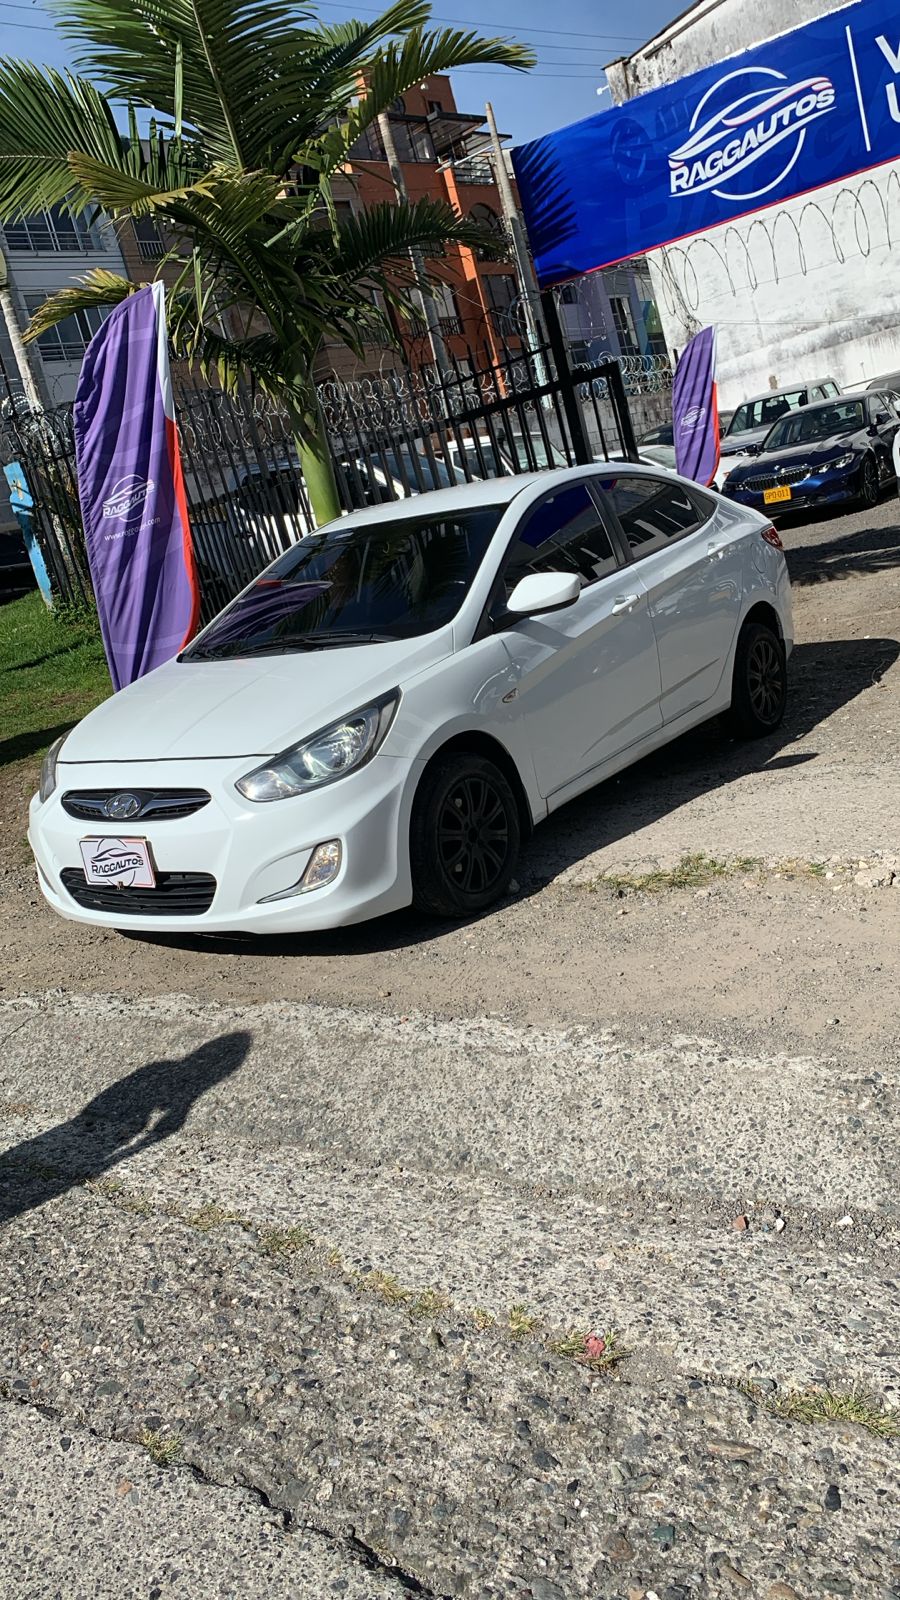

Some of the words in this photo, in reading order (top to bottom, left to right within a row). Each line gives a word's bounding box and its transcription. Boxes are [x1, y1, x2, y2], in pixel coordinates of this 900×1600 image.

[669, 86, 836, 194] RAGGAUTOS
[102, 484, 155, 517] RAGGAUTS
[91, 858, 144, 874] RAGGAUTOS
